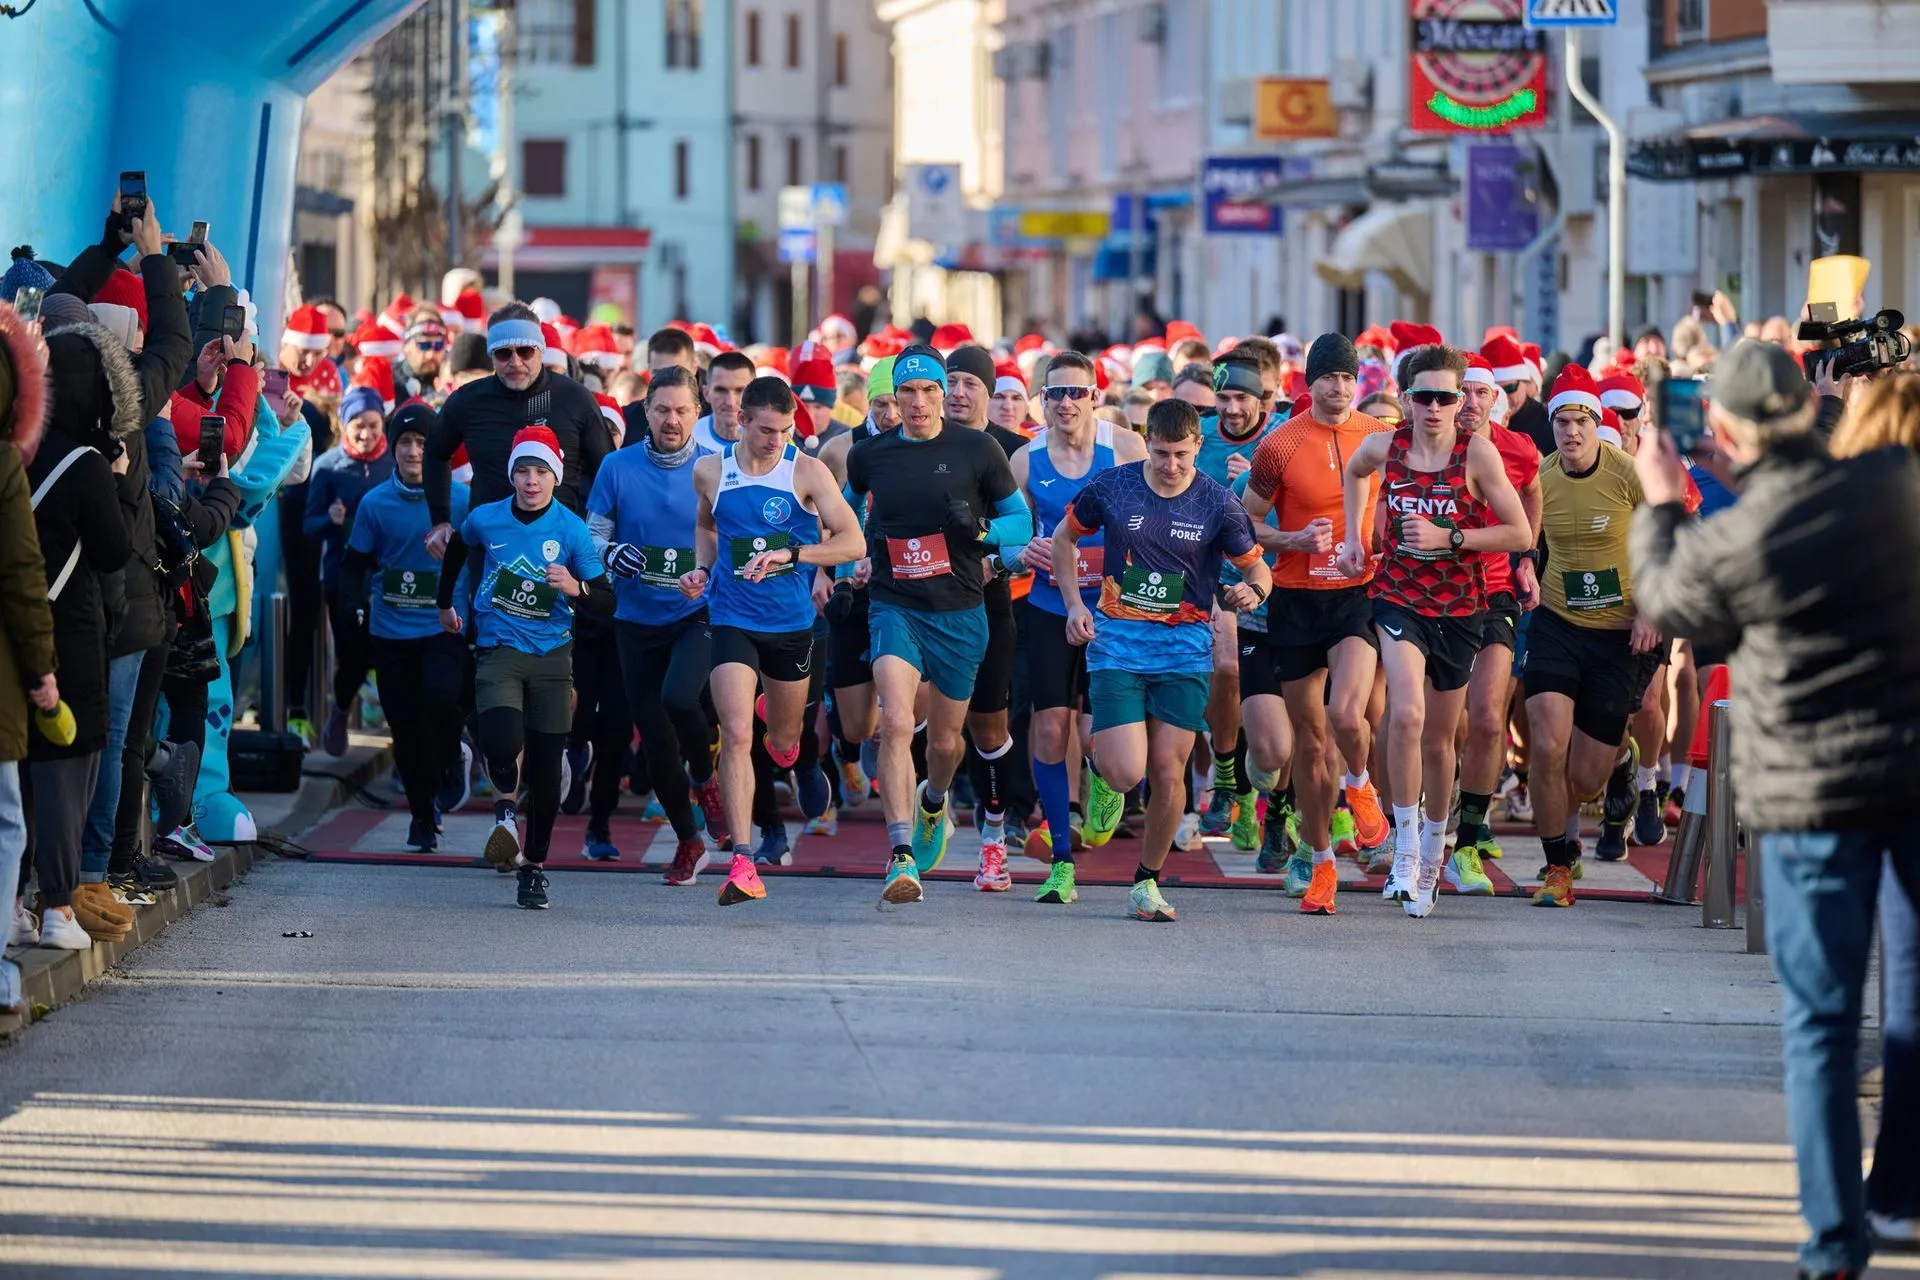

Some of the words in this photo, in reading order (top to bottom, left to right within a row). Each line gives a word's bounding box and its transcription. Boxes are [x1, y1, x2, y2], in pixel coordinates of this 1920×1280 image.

[1387, 494, 1458, 515] KENYA
[1170, 528, 1202, 541] POREČ
[903, 550, 931, 564] 420
[662, 561, 676, 574] 21
[400, 582, 417, 595] 57
[1137, 582, 1168, 599] 208
[1583, 584, 1600, 597] 39
[511, 588, 538, 606] 100
